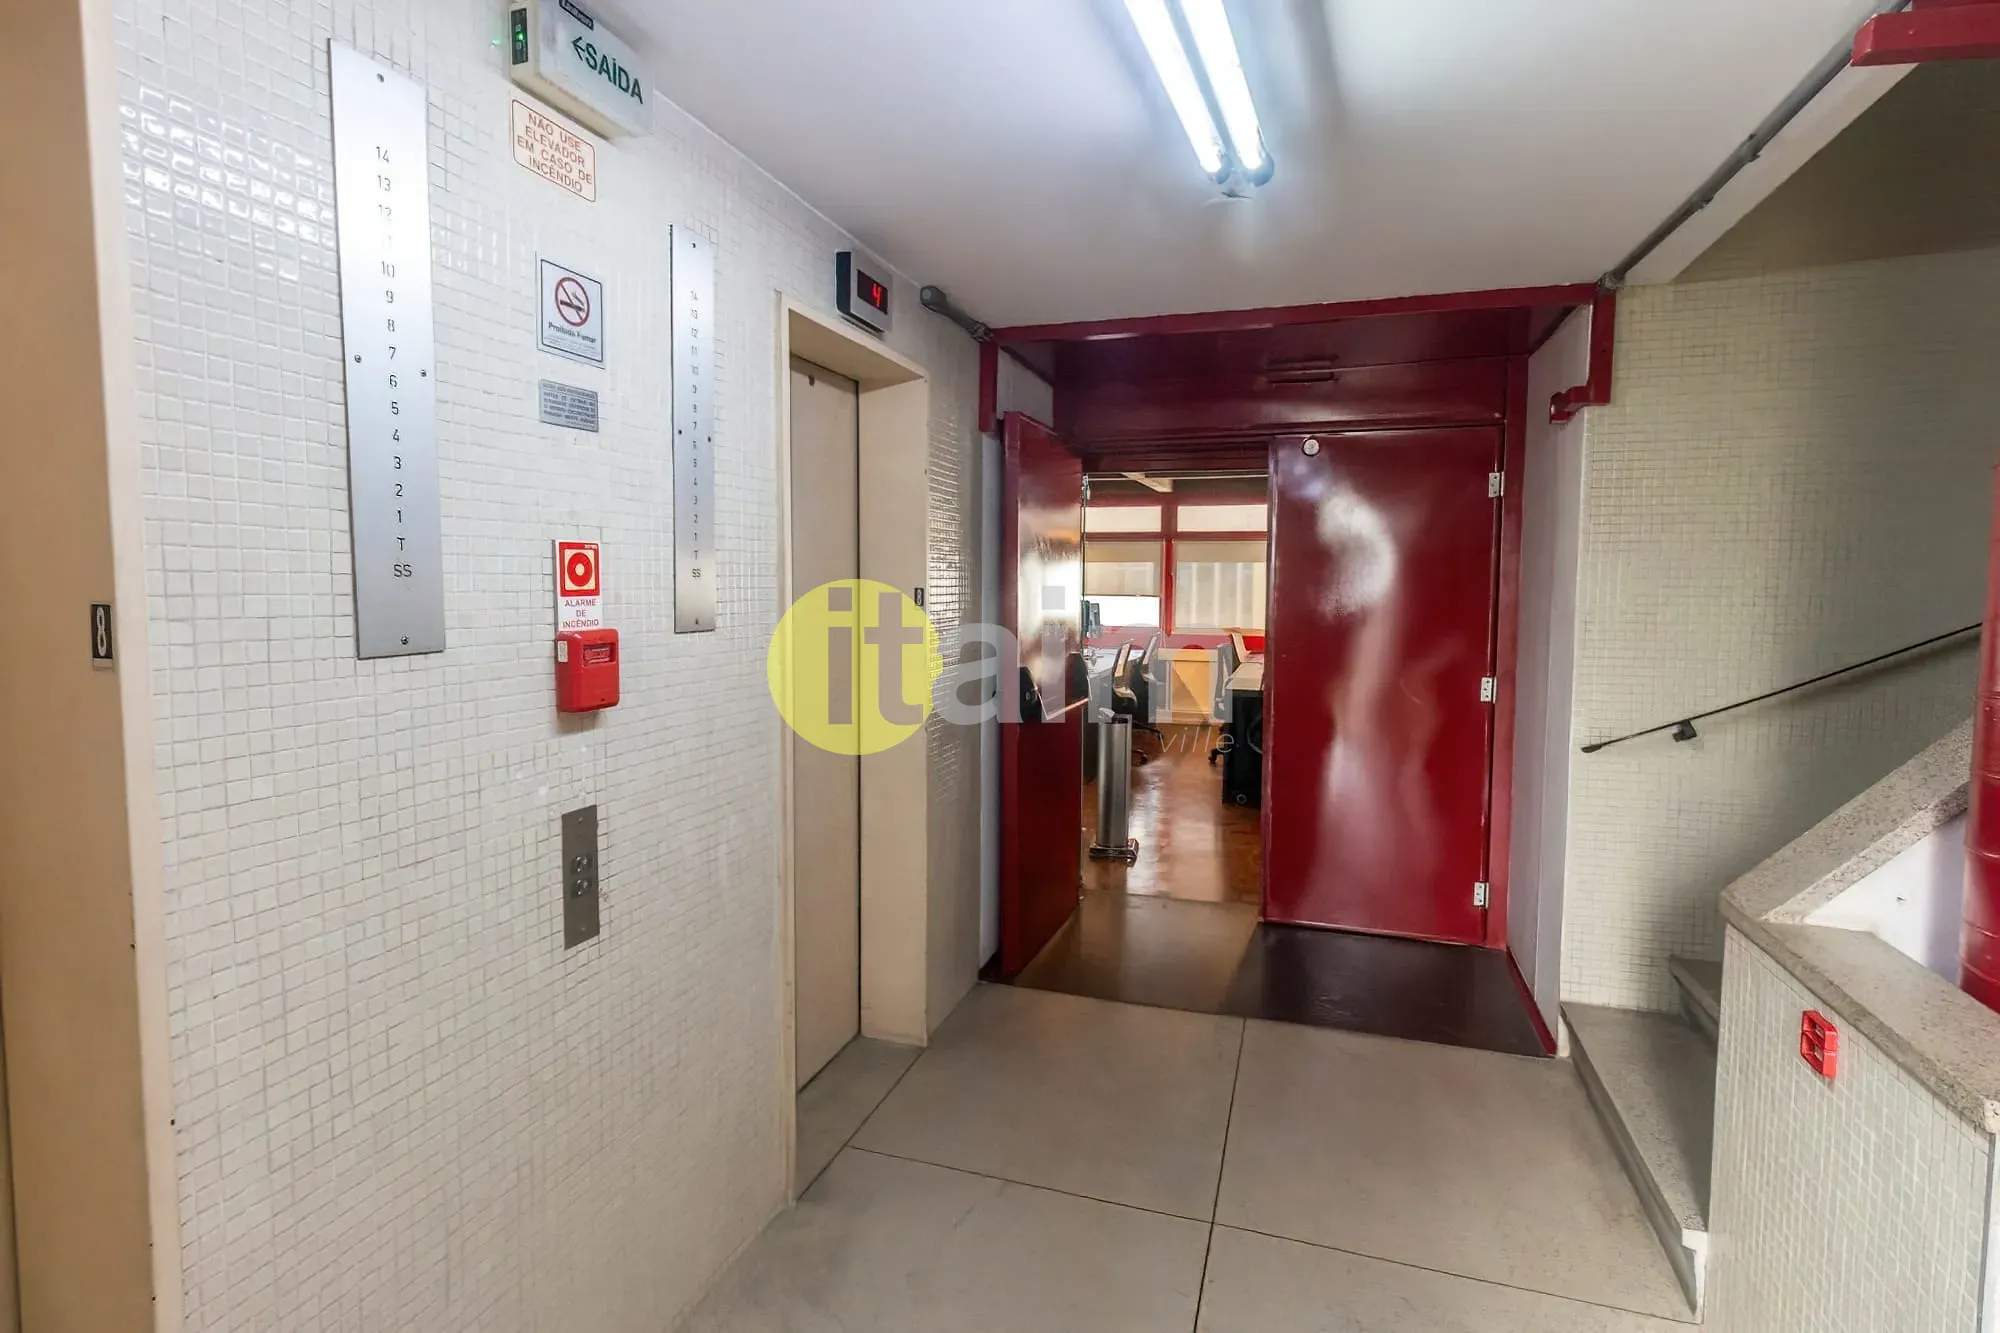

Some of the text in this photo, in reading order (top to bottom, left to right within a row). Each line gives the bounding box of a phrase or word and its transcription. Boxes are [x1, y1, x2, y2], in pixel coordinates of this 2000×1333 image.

[586, 43, 643, 104] SAÍDA
[525, 120, 585, 168] ELEVADOR
[560, 126, 582, 153] USE
[376, 146, 390, 163] 14
[517, 135, 593, 185] EM CASO DE
[529, 154, 583, 193] INCÊNDIO
[377, 175, 391, 192] 13
[381, 260, 395, 278] 10
[386, 290, 394, 304] 9
[872, 282, 881, 308] 4
[387, 318, 395, 333] 8
[389, 346, 396, 360] 7
[389, 374, 397, 388] 6
[391, 401, 399, 416] 5
[692, 421, 698, 431] 7
[392, 429, 400, 442] 4
[394, 456, 402, 470] 3
[395, 483, 403, 497] 2
[396, 510, 402, 523] 1
[693, 514, 699, 524] 2
[397, 537, 405, 551] T
[393, 563, 412, 578] SS
[691, 568, 701, 578] SS
[564, 598, 597, 608] ALARME
[575, 609, 587, 618] DE
[562, 618, 599, 629] INCÊNDIO
